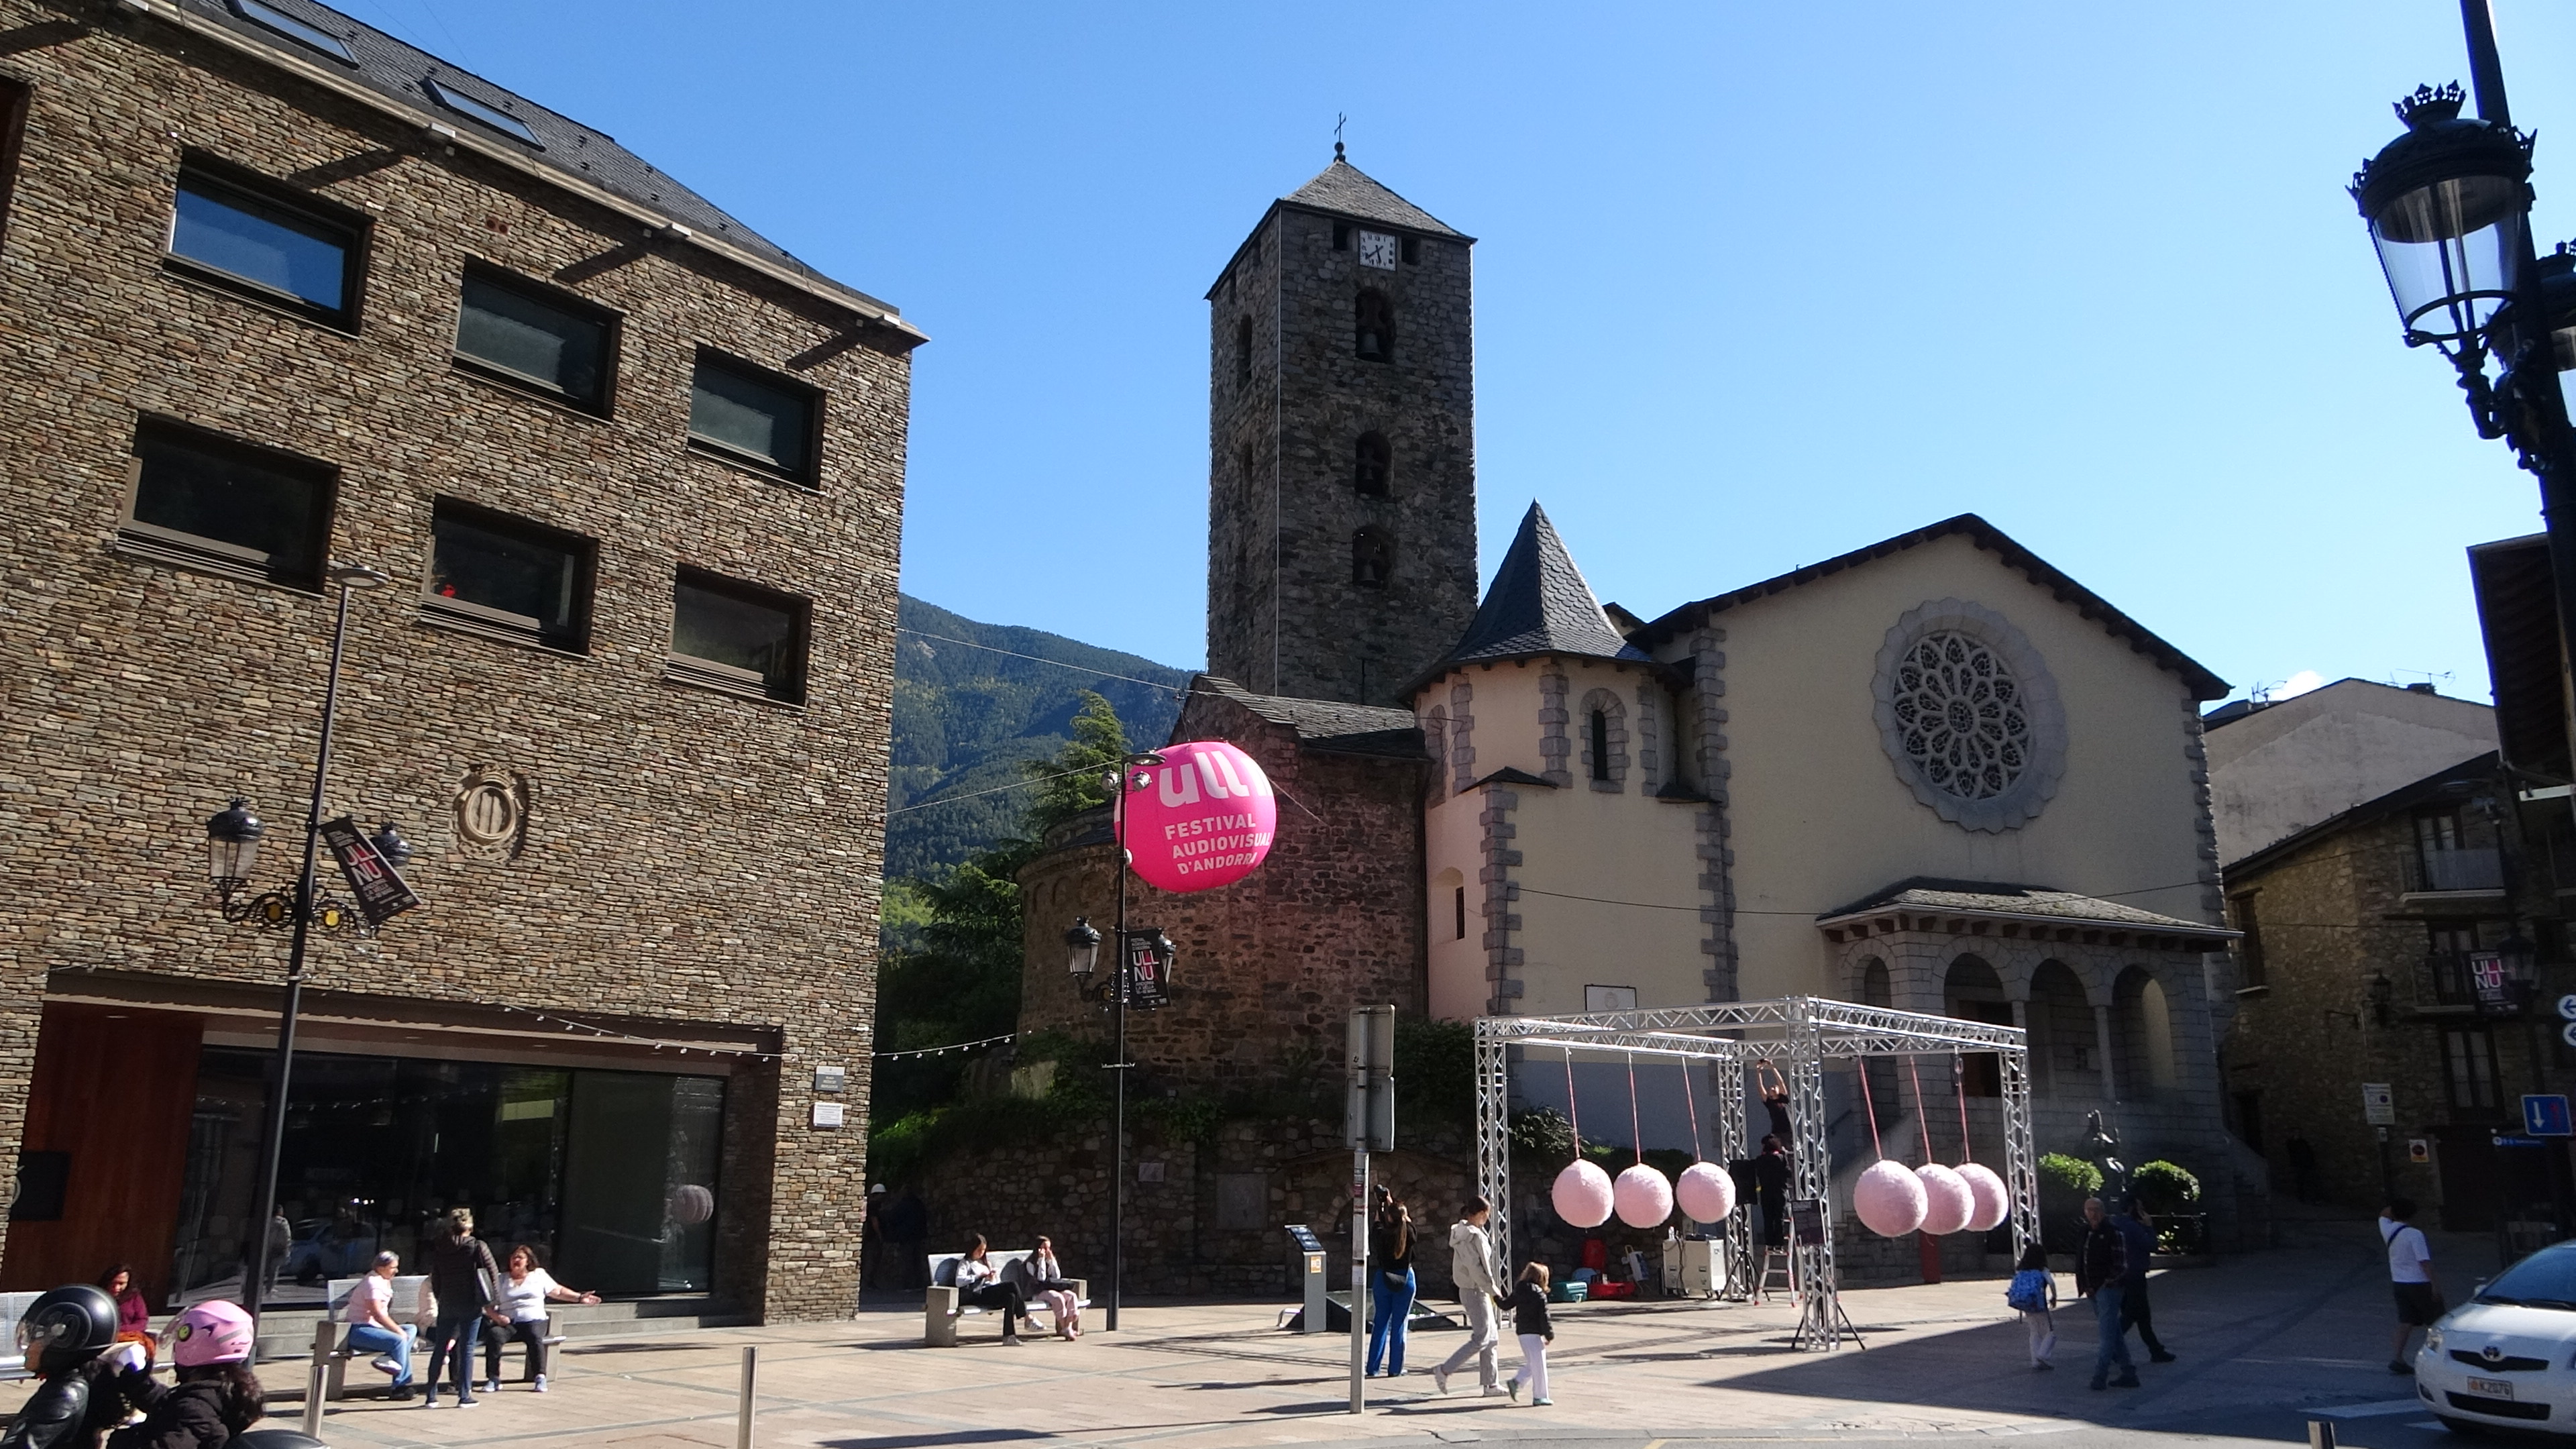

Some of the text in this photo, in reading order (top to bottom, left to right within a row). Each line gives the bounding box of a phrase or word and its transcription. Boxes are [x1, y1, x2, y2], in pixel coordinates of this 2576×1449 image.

[1165, 813, 1256, 840] FESTIVAL
[339, 843, 378, 867] ULL
[1173, 833, 1271, 859] AUDIOVISUAL
[351, 860, 382, 885] NU
[1177, 852, 1257, 875] D'ANDORRA
[1132, 950, 1160, 966] ULL
[2471, 959, 2508, 975] ULL
[1134, 965, 1155, 982] NU
[2474, 973, 2502, 989] NU
